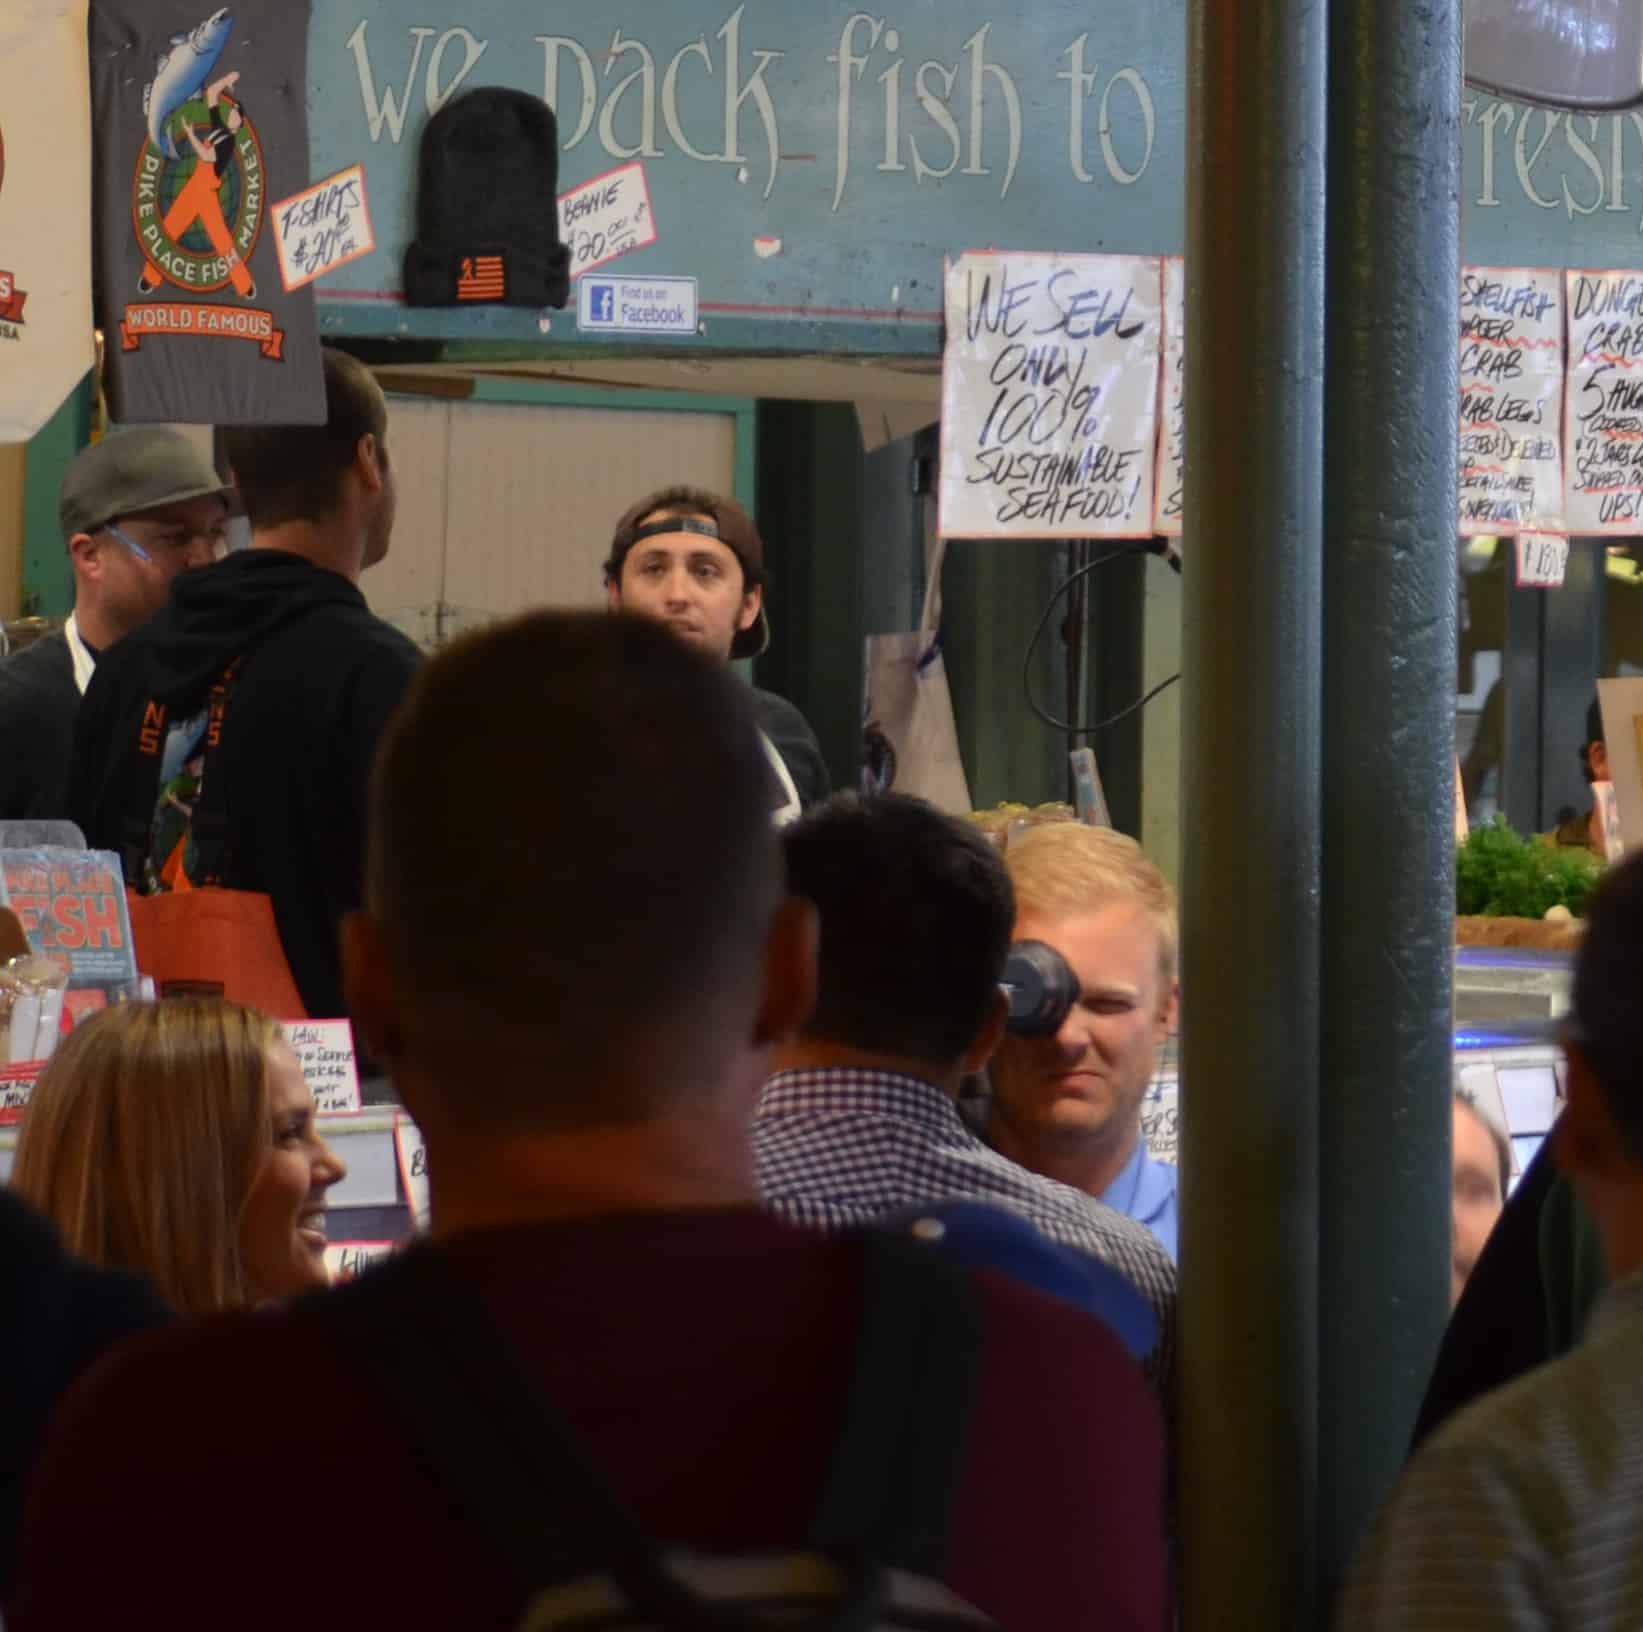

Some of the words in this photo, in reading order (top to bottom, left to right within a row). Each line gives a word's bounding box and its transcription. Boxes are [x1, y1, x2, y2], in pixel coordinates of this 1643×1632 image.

[825, 12, 1024, 212] fish
[1056, 31, 1156, 185] to
[136, 154, 160, 218] PIKE
[239, 139, 263, 248] MARKET
[142, 227, 196, 283] PLACE
[201, 247, 243, 283] FISH
[126, 307, 193, 329] WORLD
[196, 309, 272, 337] FAMOUS
[621, 302, 686, 324] Facebook
[967, 267, 1043, 341] WE
[1033, 269, 1145, 340] SELL
[990, 343, 1089, 418] ONLY
[1460, 343, 1523, 382] CRAB
[978, 385, 1101, 447] 100%
[965, 446, 1144, 492] SUSTAINABLE
